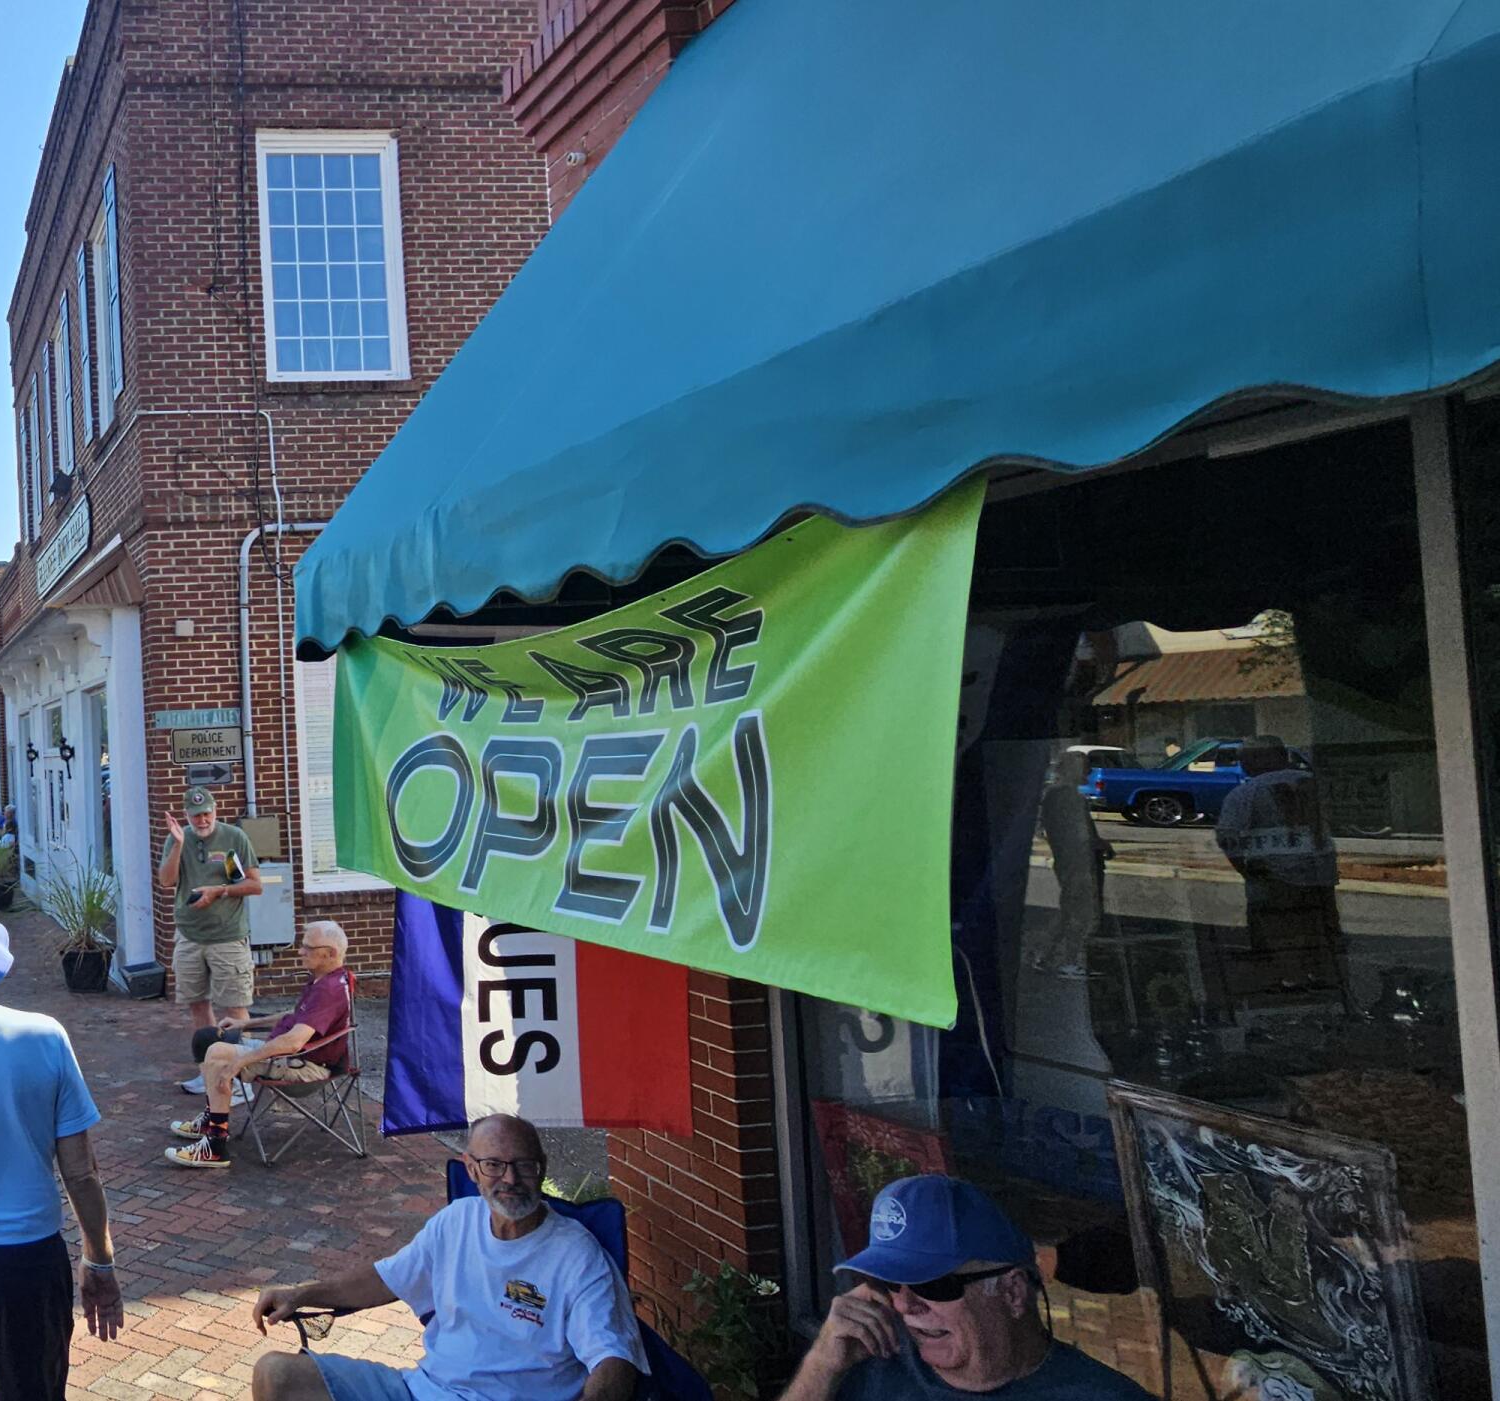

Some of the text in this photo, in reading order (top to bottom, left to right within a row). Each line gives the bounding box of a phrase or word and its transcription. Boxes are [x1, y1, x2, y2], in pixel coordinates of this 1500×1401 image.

[403, 585, 765, 724] WE ARE
[179, 745, 237, 759] DEPARTMENT
[191, 732, 224, 744] POLICE
[212, 709, 241, 725] ALLEY
[385, 709, 773, 953] OPEN
[474, 914, 561, 1076] UES
